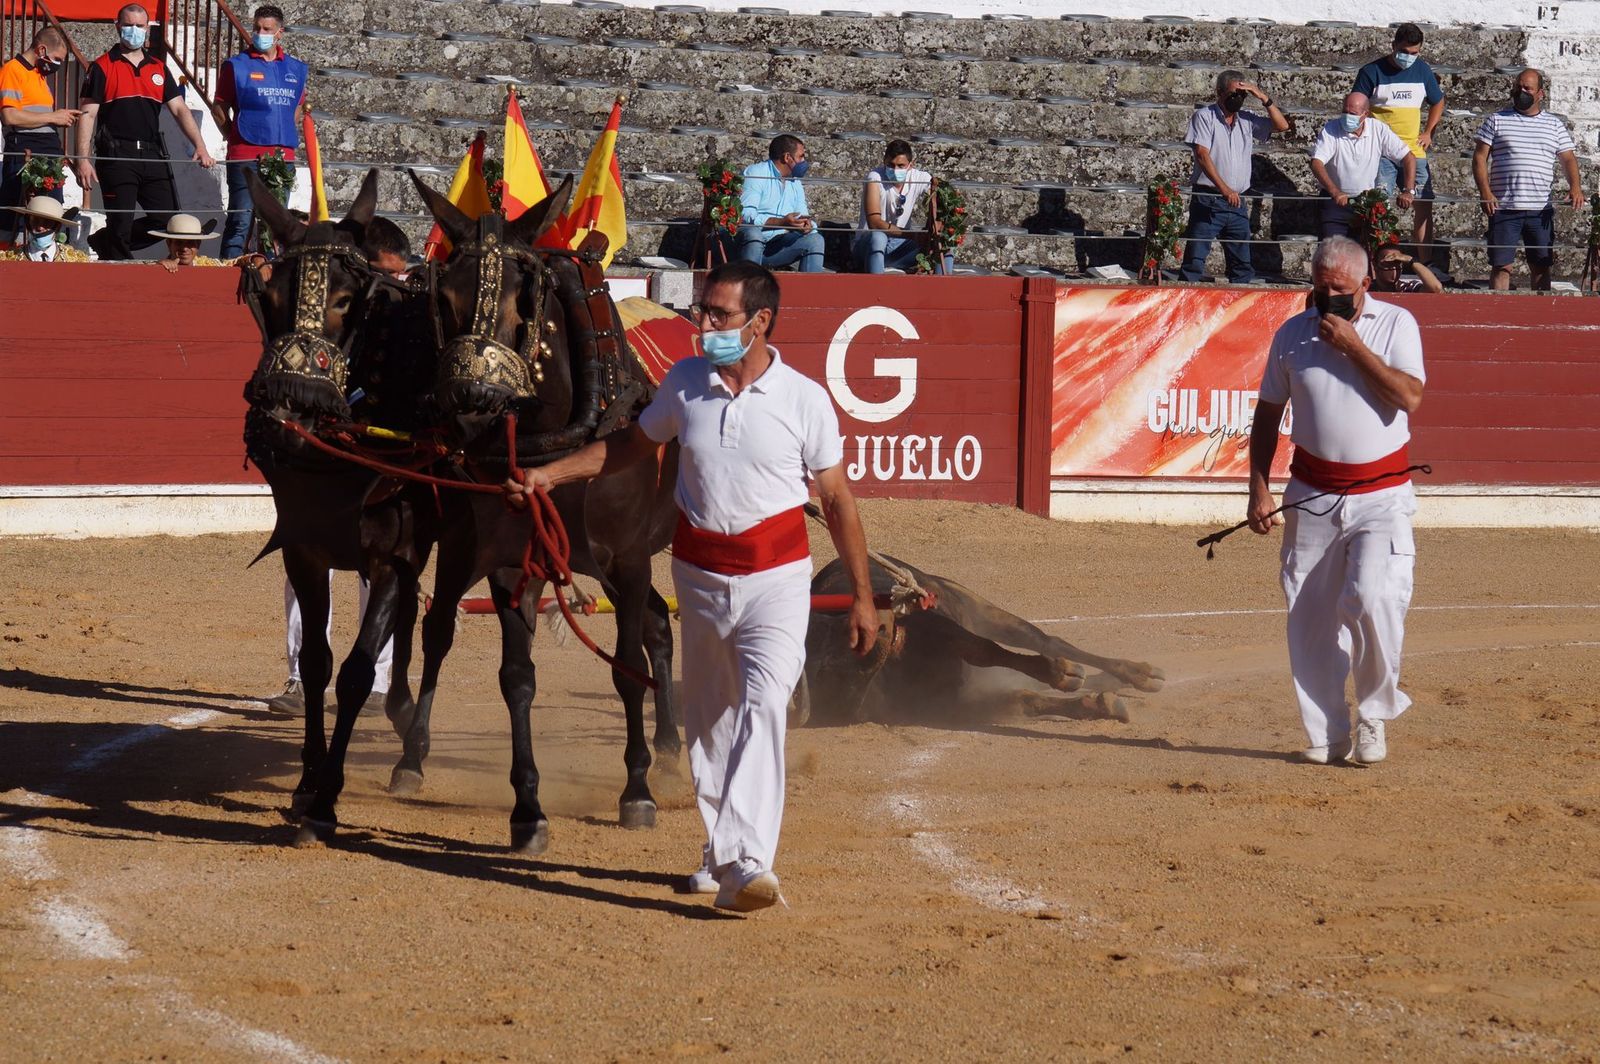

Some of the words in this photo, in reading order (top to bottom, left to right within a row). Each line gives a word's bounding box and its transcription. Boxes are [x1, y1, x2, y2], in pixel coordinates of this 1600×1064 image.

[257, 87, 296, 99] PERSONAL
[267, 96, 291, 106] PLAZA
[1391, 90, 1413, 100] VANS
[825, 305, 921, 423] G
[1147, 388, 1294, 435] GUIJUE
[838, 434, 982, 481] JUELO
[1202, 424, 1253, 473] gus
